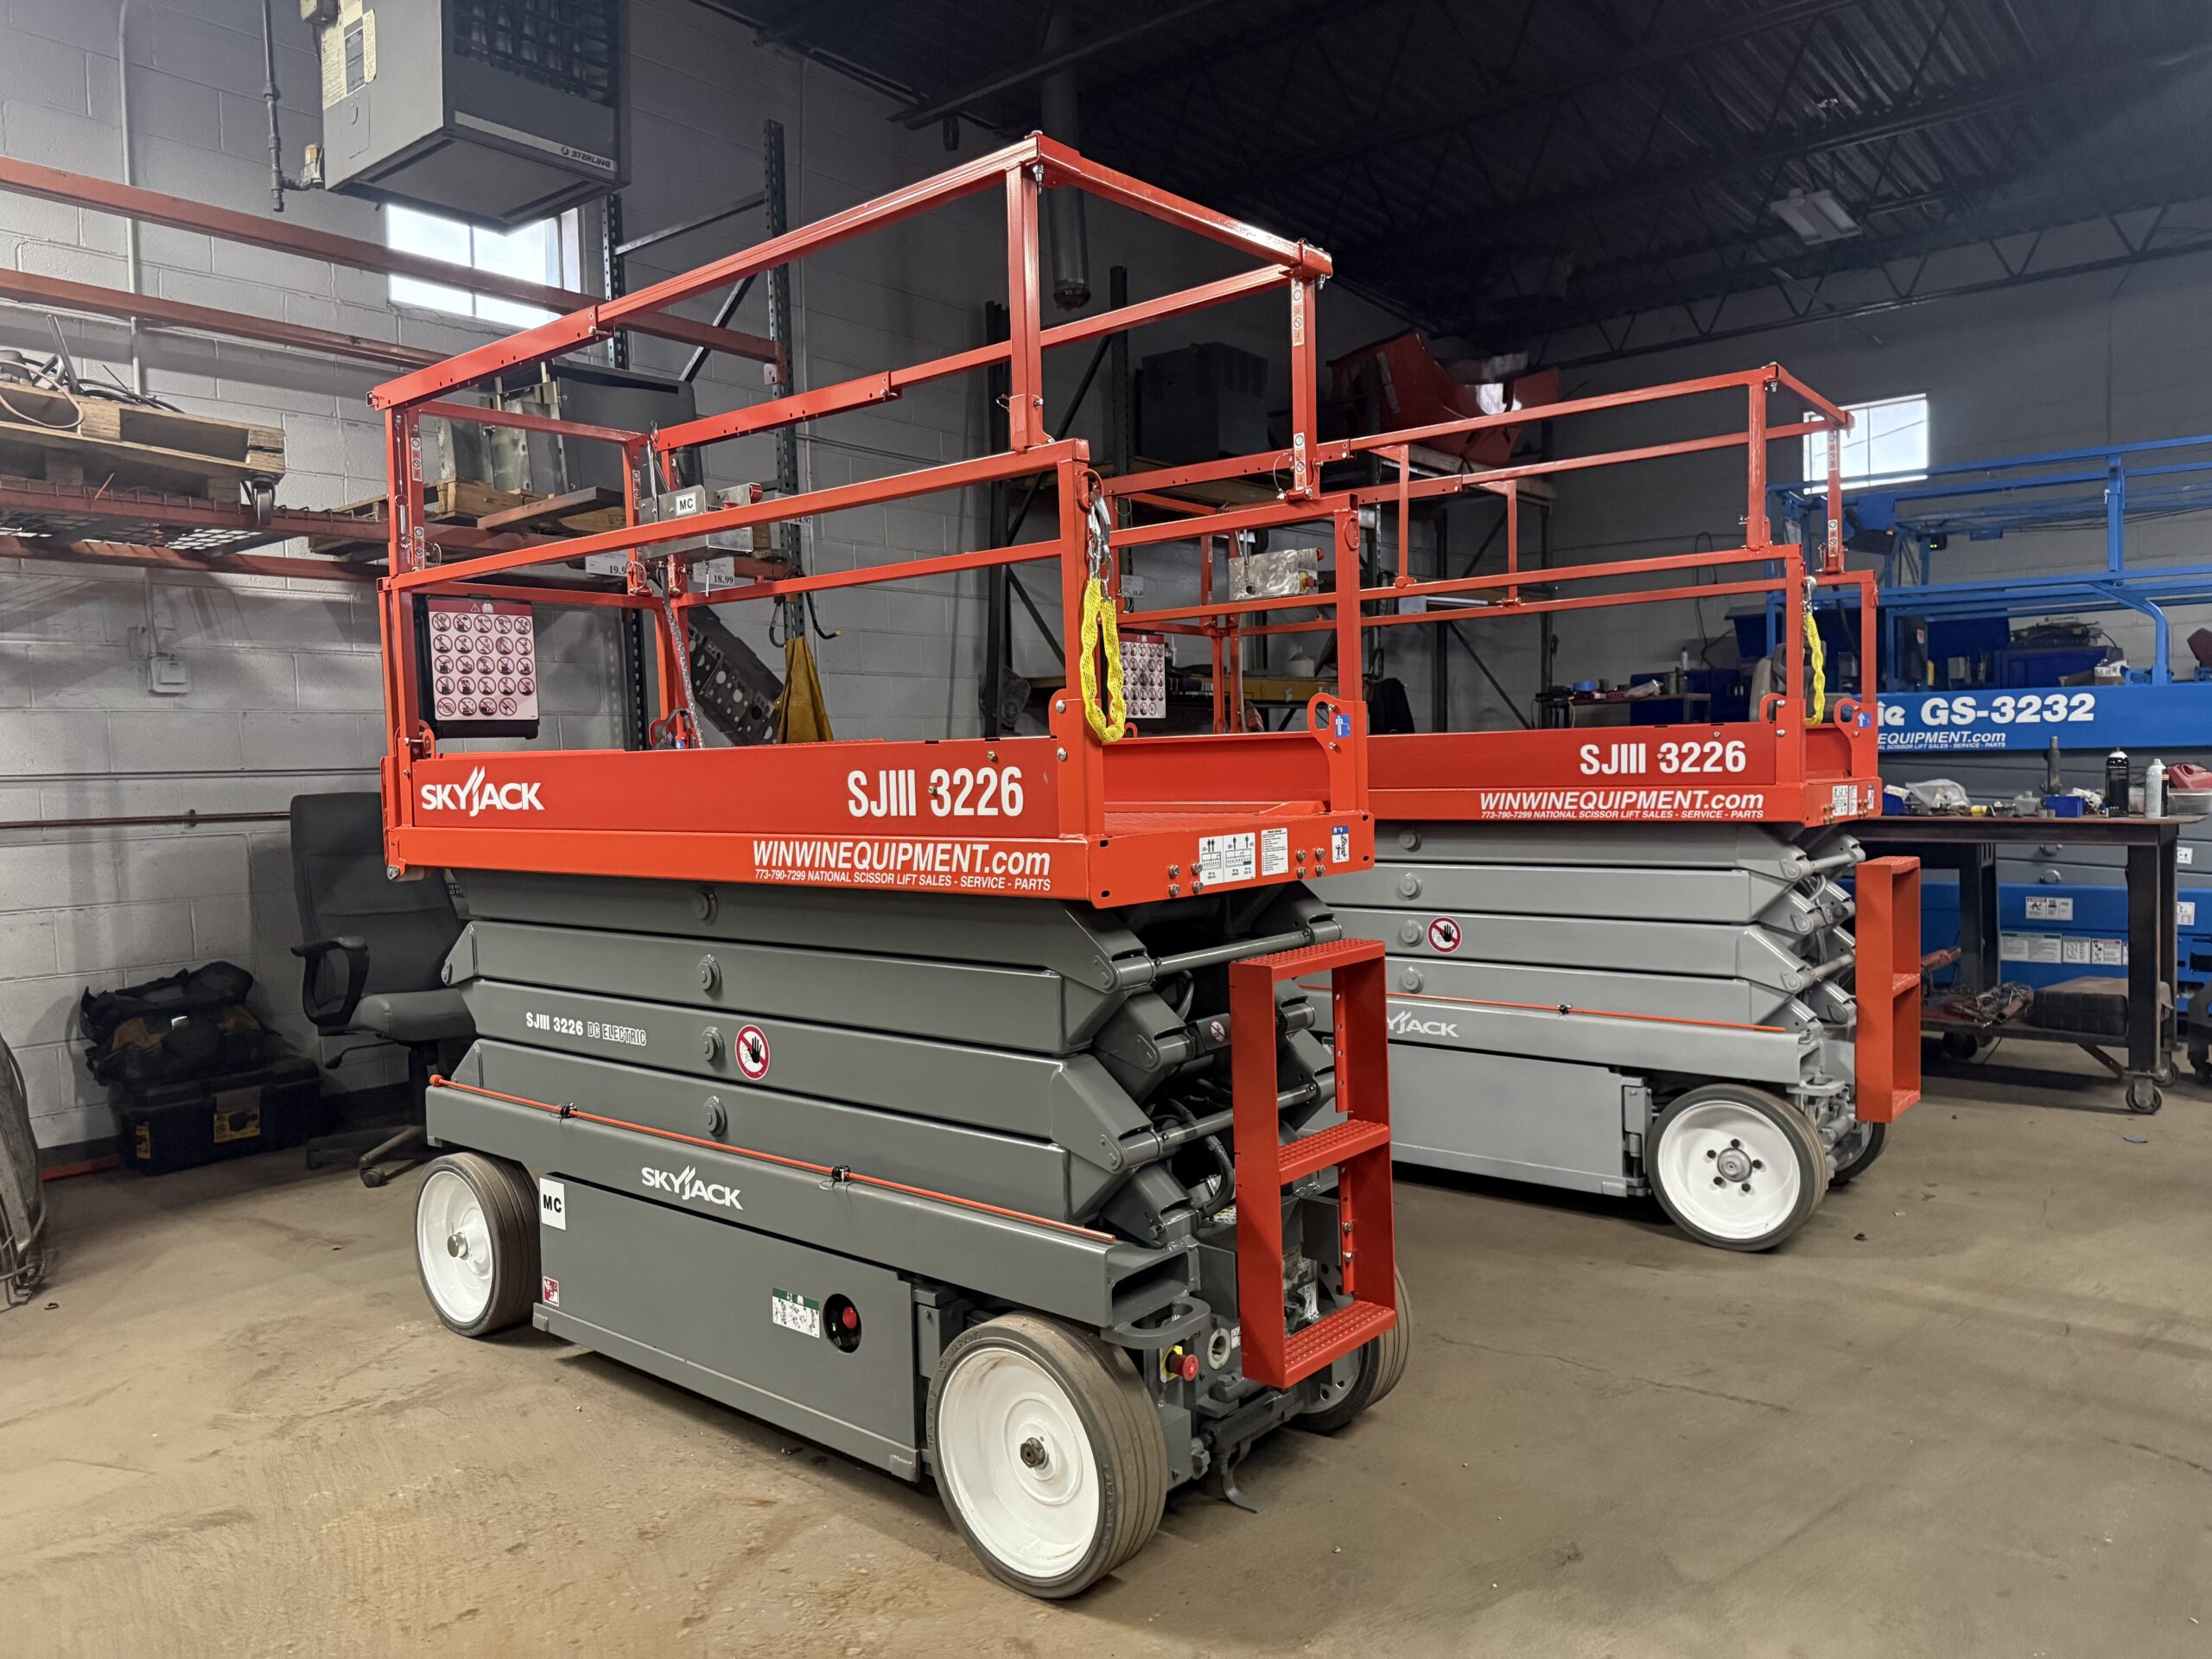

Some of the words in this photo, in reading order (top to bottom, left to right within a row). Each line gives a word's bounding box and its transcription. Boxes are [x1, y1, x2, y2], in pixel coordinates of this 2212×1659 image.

[571, 150, 611, 168] STERLING
[679, 498, 693, 511] MC
[609, 565, 627, 575] 19.9
[714, 574, 734, 584] 18.99
[1921, 693, 2095, 727] GS-3232
[1878, 731, 2006, 745] EQUIPMENT.com
[1580, 743, 1646, 775] SJIII
[1660, 741, 1746, 773] 3226
[421, 766, 545, 817] SKYJACK
[848, 769, 916, 817] SJIII
[930, 766, 1024, 817] 3226
[1480, 790, 1764, 810] WINWINEQUIPMENT.com
[1481, 810, 1532, 819] 773-790-7299
[1534, 810, 1576, 819] NATIONAL
[1579, 810, 1618, 819] SCISSOR
[1642, 810, 1674, 818] SALES
[1681, 810, 1723, 818] SERVICE
[1731, 810, 1764, 818] PARTS
[753, 840, 1051, 876] WINWINEQUIPMENT.com
[755, 868, 805, 880] 773-790-7299
[808, 870, 851, 882] NATIONAL
[854, 872, 894, 884] SCISSOR
[897, 873, 917, 885] LIFT
[918, 874, 951, 887] SALES
[960, 875, 1006, 889] SERVICE
[1014, 878, 1051, 891] PARTS
[525, 1011, 550, 1031] SJIII
[553, 1016, 583, 1036] 3226
[588, 1021, 601, 1039] DC
[602, 1023, 647, 1046] ELECTRIC
[1387, 1010, 1459, 1038] YJACK
[640, 1165, 744, 1211] SKYJACK
[543, 1194, 562, 1213] MC
